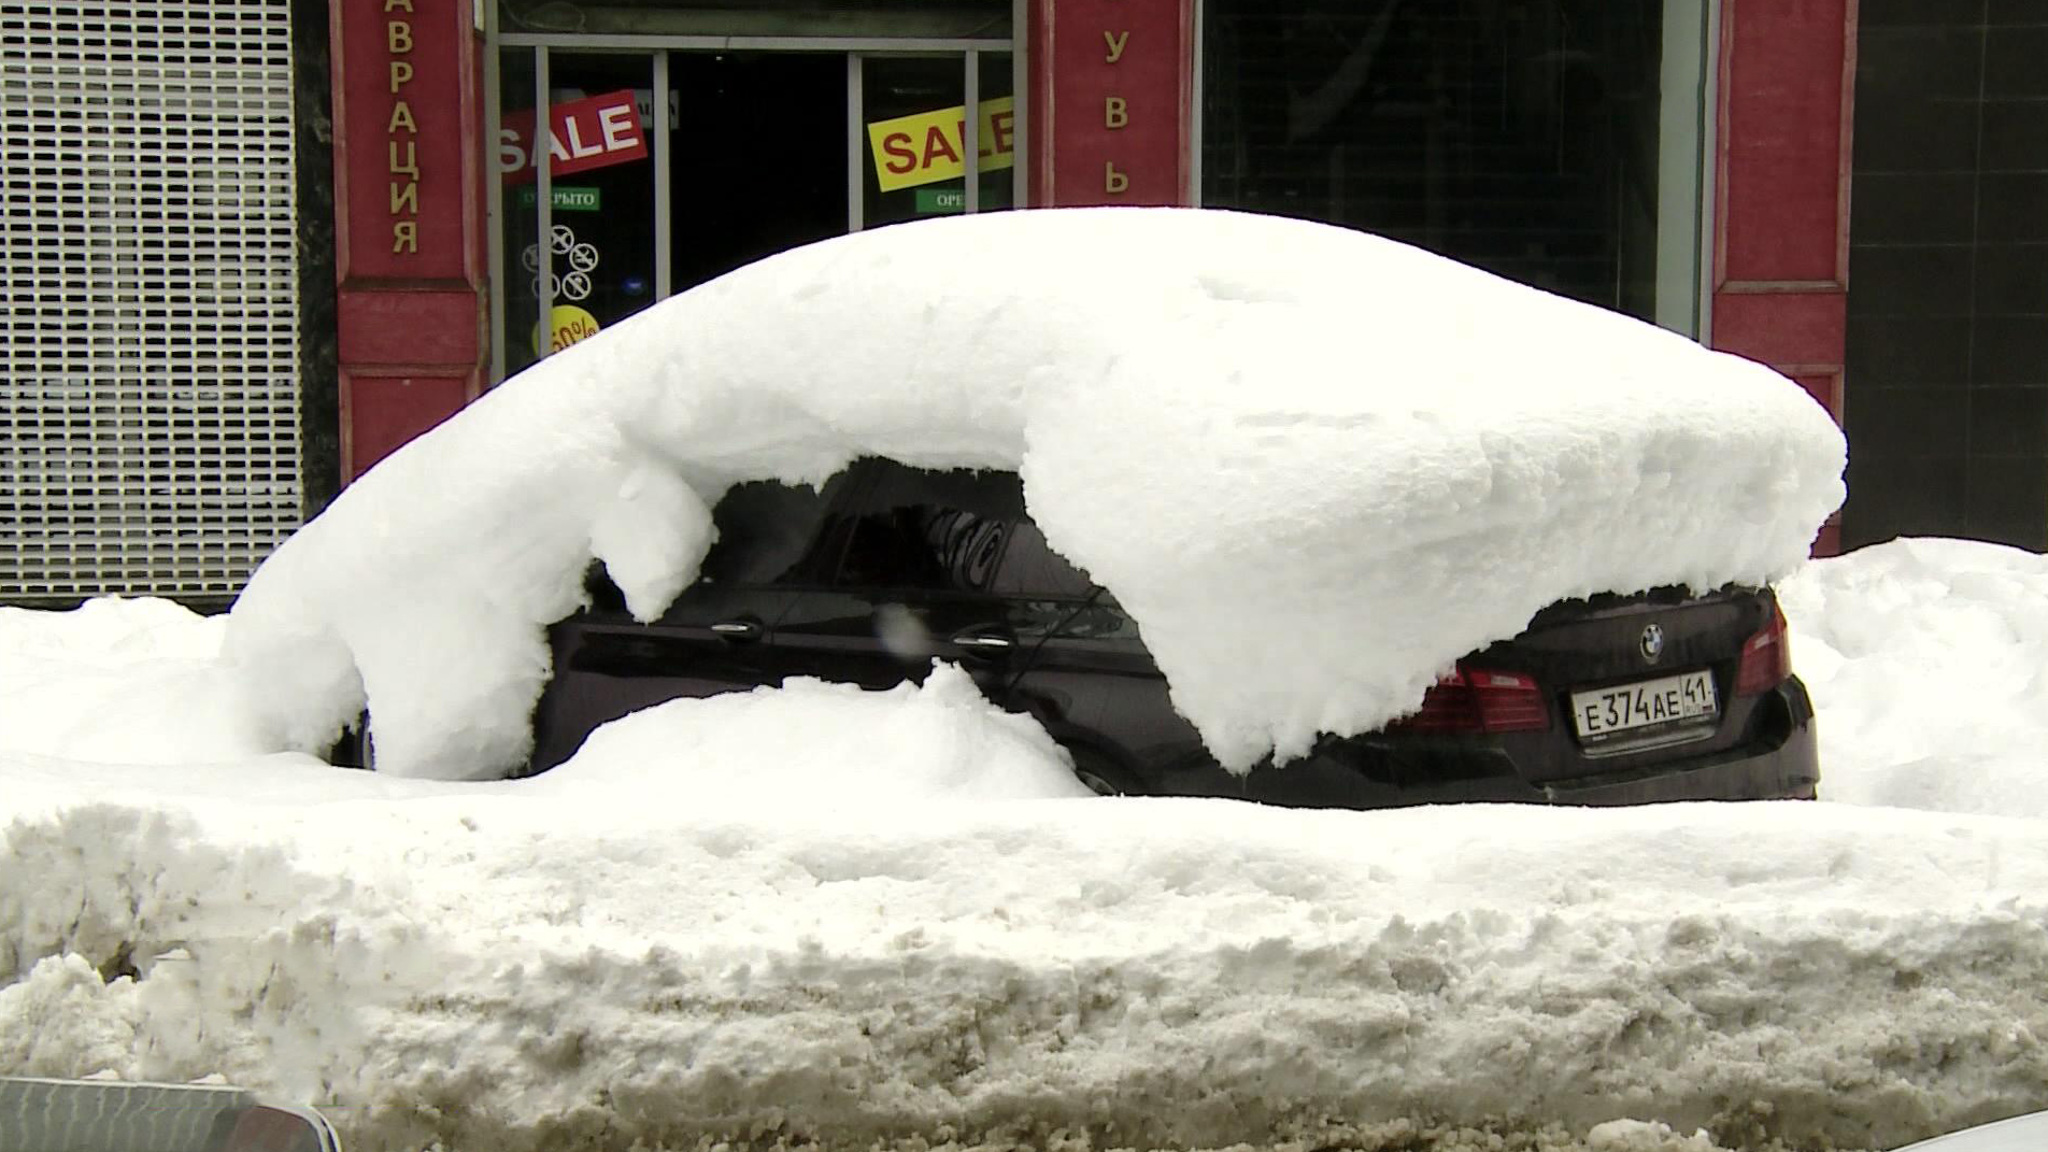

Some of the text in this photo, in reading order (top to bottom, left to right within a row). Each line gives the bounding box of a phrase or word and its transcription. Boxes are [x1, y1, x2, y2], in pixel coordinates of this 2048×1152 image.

[500, 104, 640, 173] SALE
[523, 191, 596, 206] ОРЫТО
[936, 193, 967, 207] OPE
[1684, 676, 1707, 703] 41
